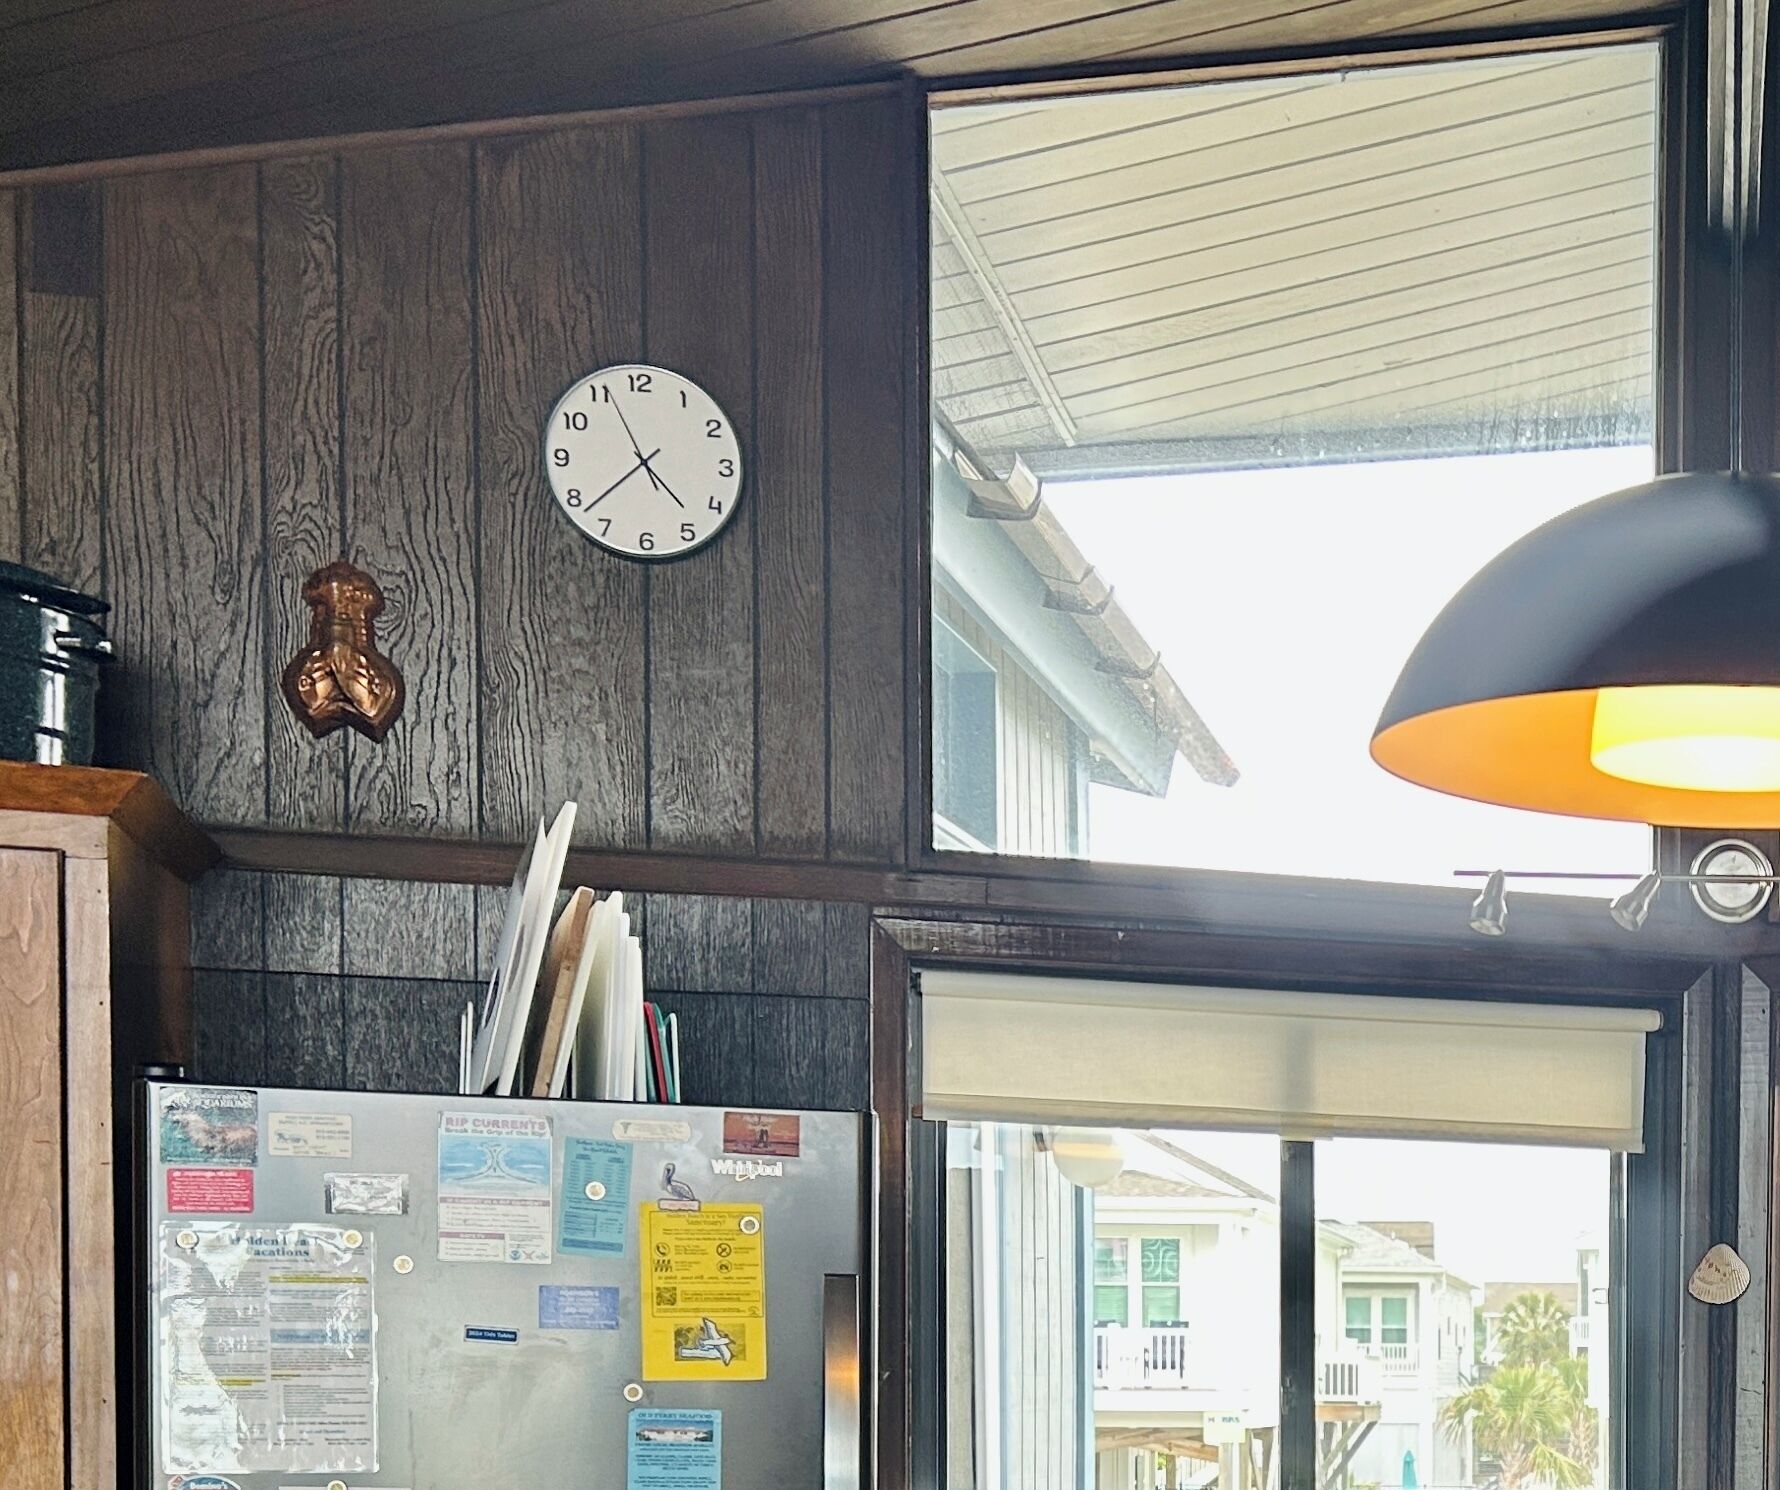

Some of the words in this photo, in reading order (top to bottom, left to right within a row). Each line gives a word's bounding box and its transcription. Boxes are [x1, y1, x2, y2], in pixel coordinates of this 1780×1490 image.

[628, 374, 652, 393] 12
[590, 384, 609, 403] 11
[679, 390, 687, 408] 1
[563, 412, 588, 431] 10
[706, 419, 722, 438] 2
[554, 448, 570, 467] 9
[718, 459, 734, 477] 3
[567, 489, 582, 507] 8
[708, 496, 722, 515] 4
[598, 518, 612, 537] 7
[680, 523, 696, 542] 5
[639, 532, 654, 551] 6
[445, 1117, 468, 1127] RIP
[472, 1118, 546, 1131] CURRENTS
[710, 1159, 783, 1180] Whirlpool
